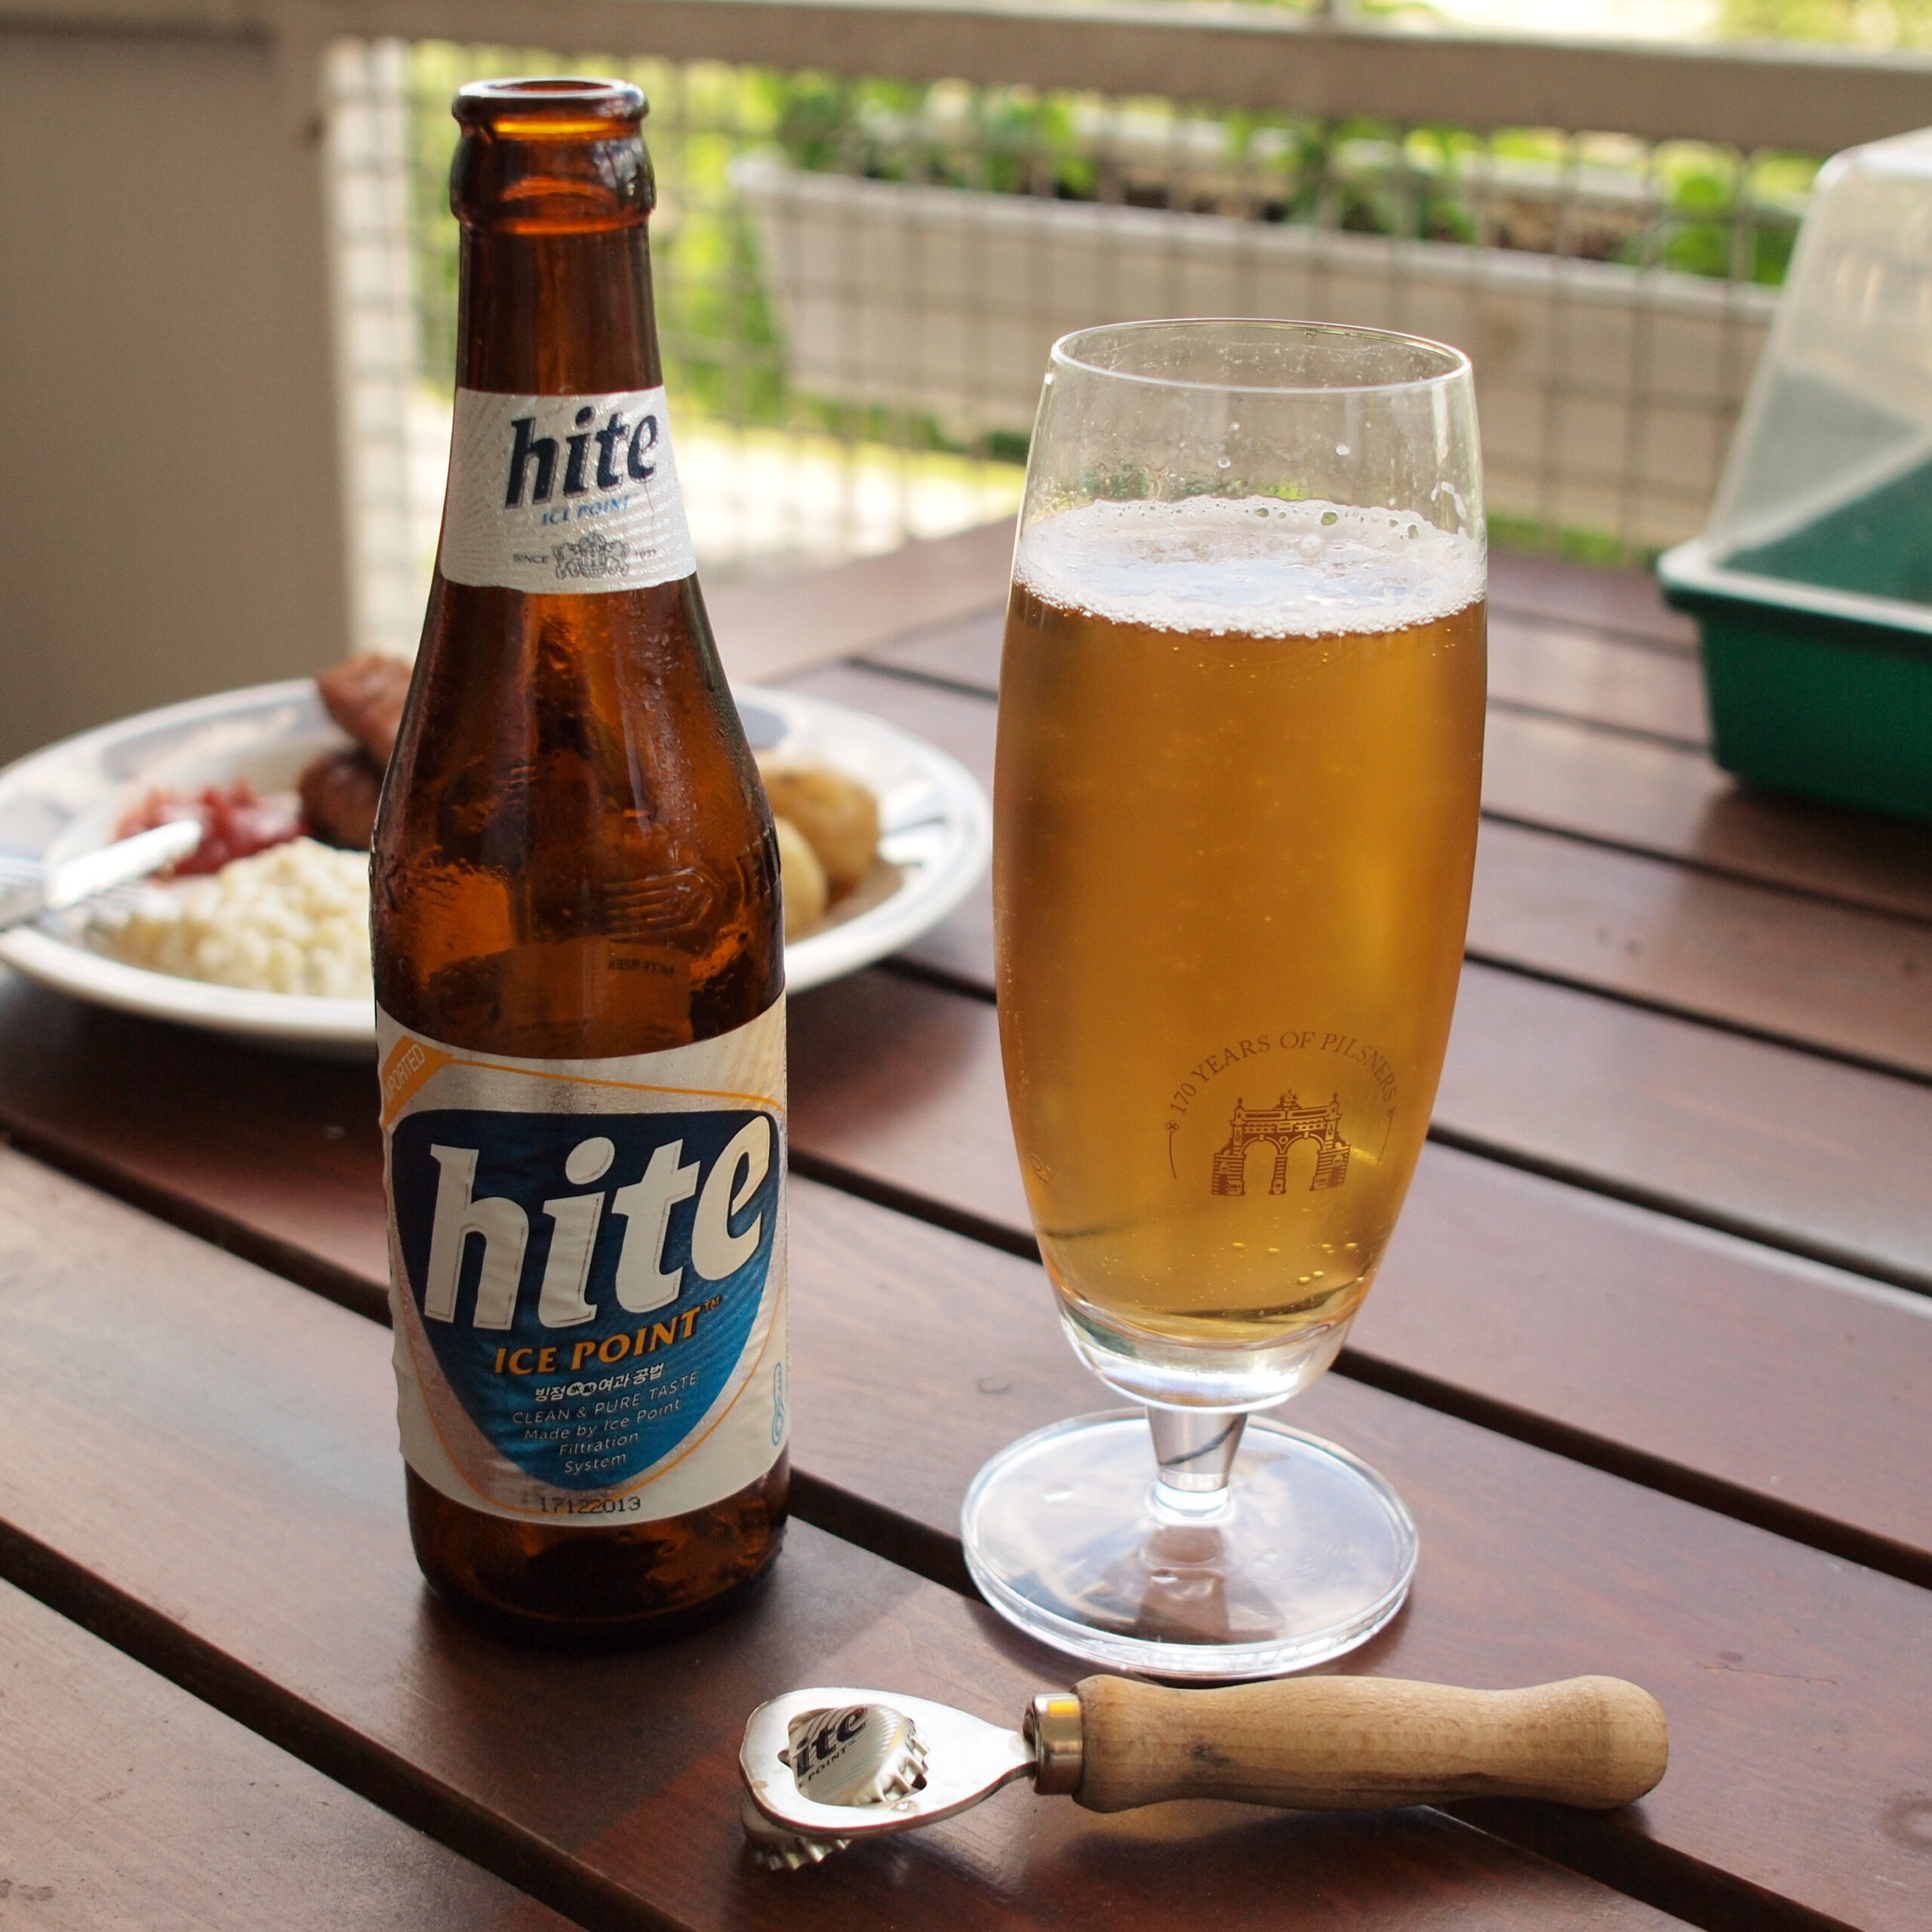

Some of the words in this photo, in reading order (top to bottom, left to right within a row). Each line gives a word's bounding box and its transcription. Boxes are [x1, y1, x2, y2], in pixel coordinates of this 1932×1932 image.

[505, 406, 659, 509] hite
[513, 554, 549, 565] SINCE
[1171, 1082, 1198, 1114] 170
[1190, 1035, 1270, 1083] YEARS
[1280, 1031, 1316, 1049] OF
[1320, 1032, 1397, 1102] PILSNERS
[424, 1115, 771, 1331] hite
[494, 1347, 557, 1375] ICE
[571, 1306, 702, 1371] POINT
[512, 1408, 570, 1425] CLEAN
[576, 1406, 587, 1419] &
[595, 1393, 641, 1416] PURE
[649, 1371, 699, 1401] TASTE
[525, 1426, 570, 1441] Made
[577, 1424, 597, 1438] by
[604, 1416, 629, 1431] Ice
[636, 1399, 681, 1423] Point
[559, 1432, 639, 1456] Filtration
[565, 1453, 626, 1475] System
[540, 1496, 641, 1514] 17122013
[792, 1707, 868, 1778] ite
